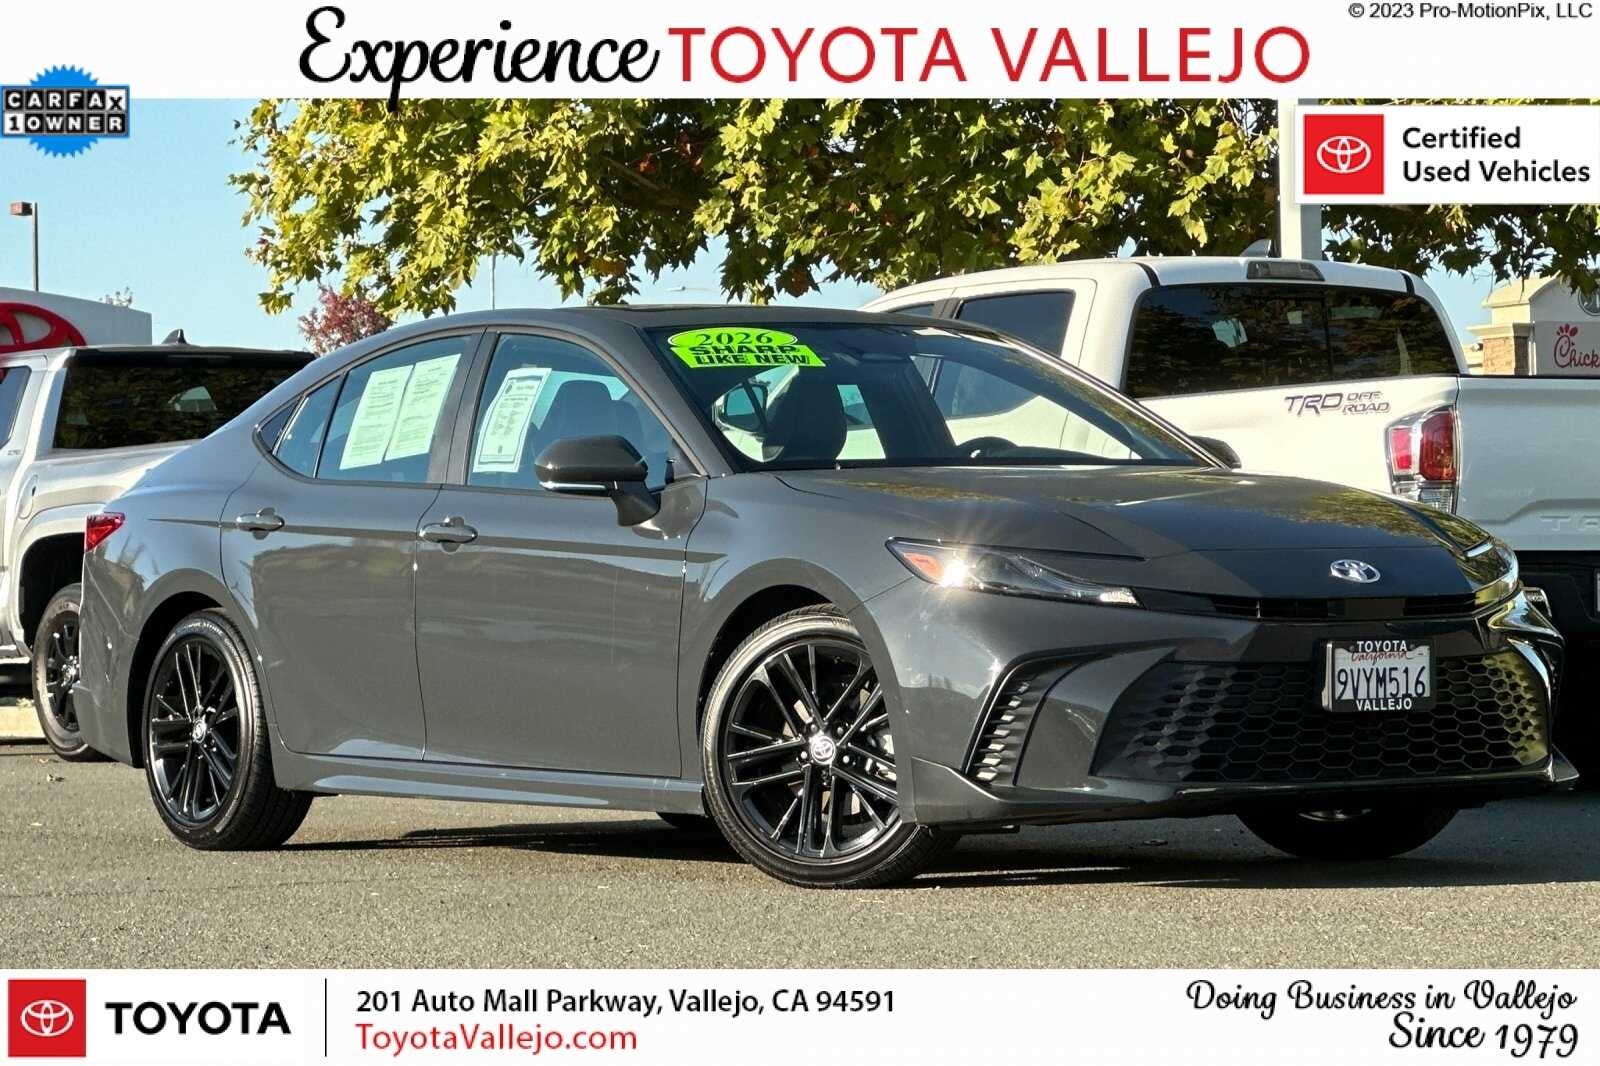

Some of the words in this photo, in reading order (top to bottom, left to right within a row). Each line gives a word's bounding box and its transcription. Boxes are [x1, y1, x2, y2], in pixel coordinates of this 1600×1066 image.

[695, 332, 774, 347] 2026
[688, 344, 800, 356] SHARP
[693, 353, 746, 365] LIKE
[756, 352, 810, 364] NEW
[1346, 391, 1383, 401] OFF
[1284, 392, 1344, 416] TRD
[1343, 402, 1391, 414] ROAD
[1356, 640, 1408, 652] TOYOTA
[1337, 665, 1426, 699] 9VYM516
[1355, 698, 1413, 711] VALLEJO
